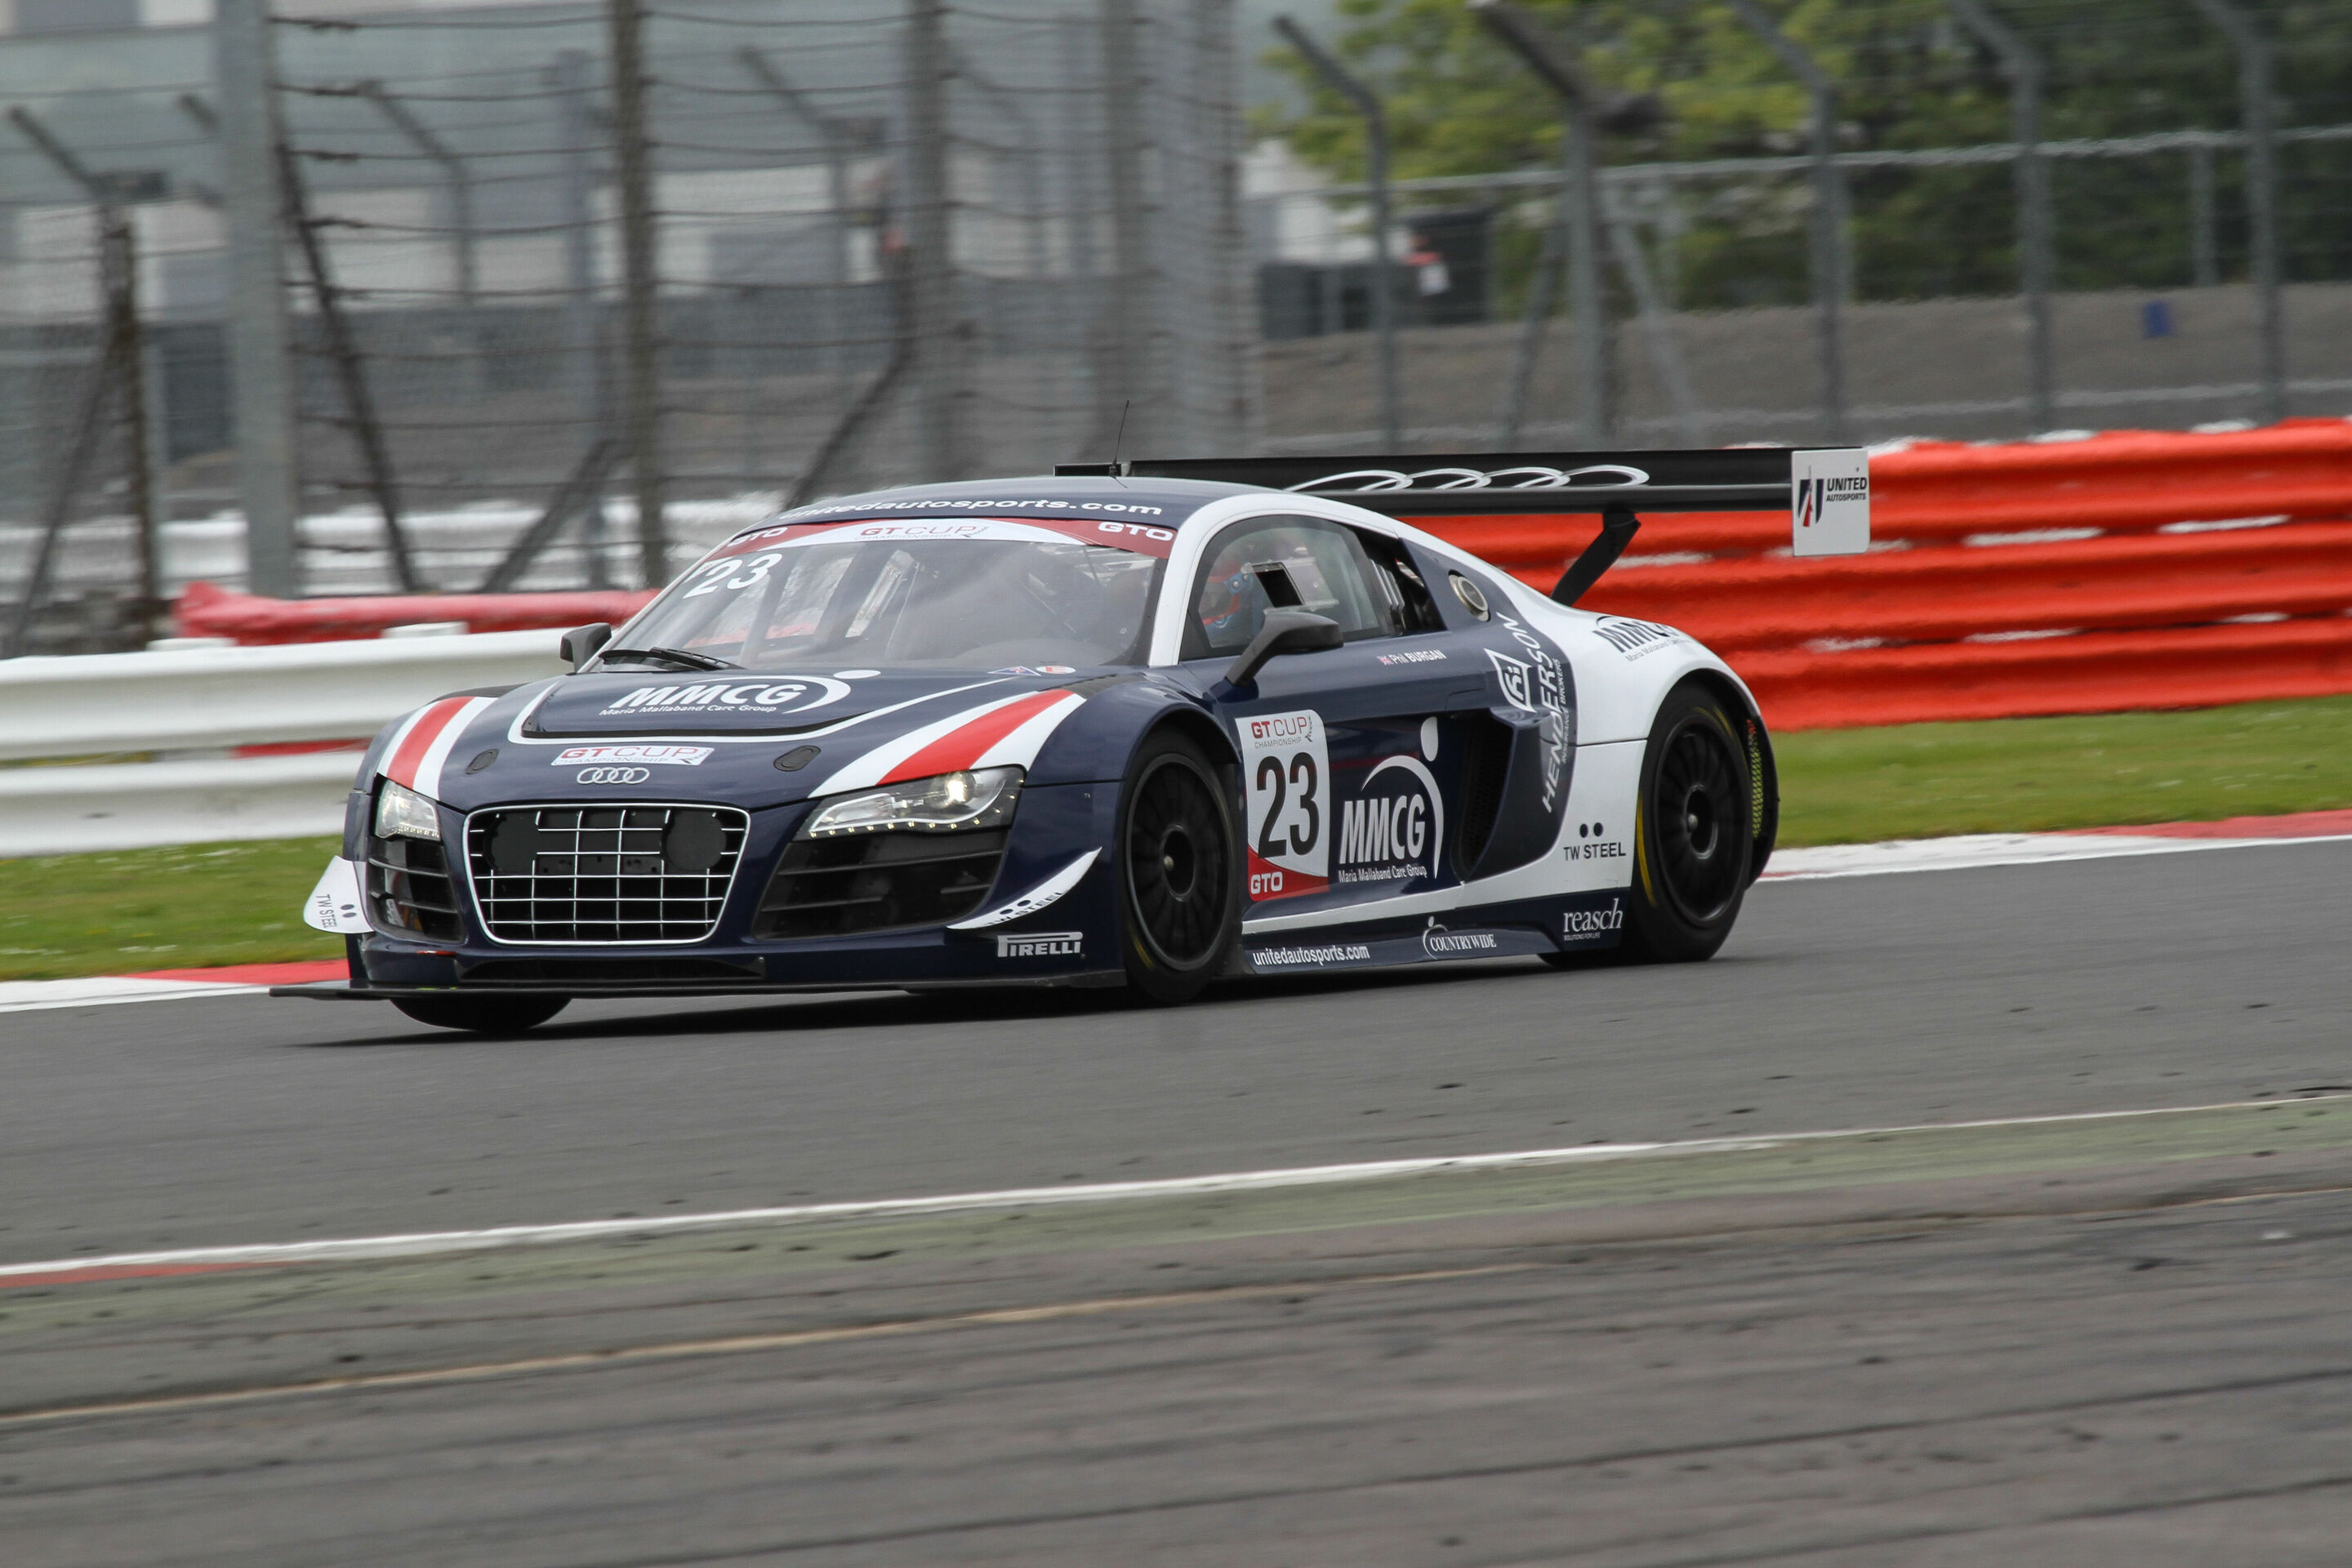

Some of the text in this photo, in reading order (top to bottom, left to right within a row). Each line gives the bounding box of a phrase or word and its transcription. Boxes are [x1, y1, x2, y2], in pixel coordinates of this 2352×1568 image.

[1826, 477, 1868, 492] UNITED
[1825, 492, 1867, 502] AUTOSPORTS
[860, 525, 978, 537] GT CUP
[1098, 521, 1174, 542] GTO
[682, 553, 784, 599] 23
[1404, 649, 1447, 663] BURGAN
[1552, 658, 1567, 705] BROKERS
[608, 684, 808, 708] MMCG
[598, 704, 777, 716] Maria Mallaband Care Group
[1496, 612, 1566, 813] HENDERSON
[1250, 716, 1308, 739] GT CUP
[559, 746, 699, 759] GT CUP
[1254, 737, 1303, 750] CHAMPIONSHIP
[1256, 751, 1320, 858] 23
[1339, 794, 1426, 864] MMCG
[1563, 841, 1627, 862] TW STEEL
[1250, 871, 1284, 895] GTO
[1339, 864, 1428, 883] Maria Mallaband Care Group
[315, 893, 333, 908] TW
[1563, 898, 1624, 933] reasch
[997, 931, 1084, 958] PIRELLI
[1430, 933, 1497, 952] COUNTRYWIDE
[1252, 945, 1370, 967] unitedautosports.com
